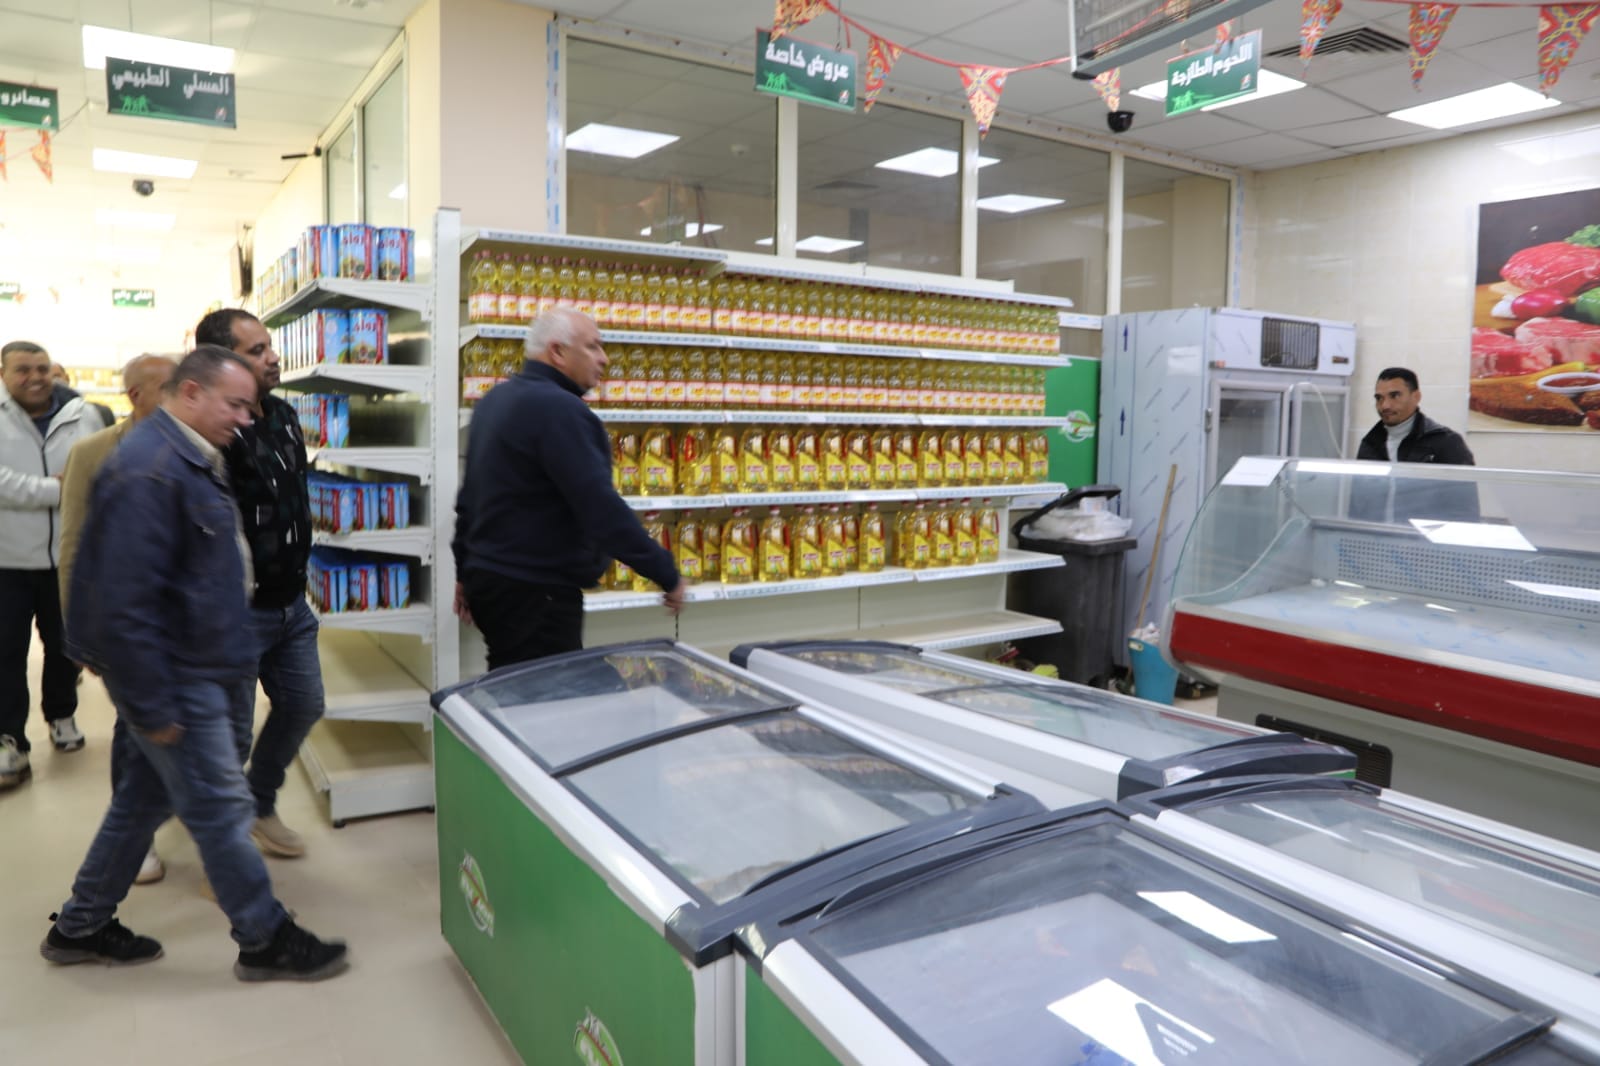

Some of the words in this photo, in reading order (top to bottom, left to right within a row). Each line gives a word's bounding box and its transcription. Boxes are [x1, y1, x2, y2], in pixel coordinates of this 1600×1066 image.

[765, 42, 806, 68] خاصة
[807, 54, 849, 81] عروض
[1213, 42, 1253, 76] اللحوم
[1171, 55, 1213, 86] الطازجة
